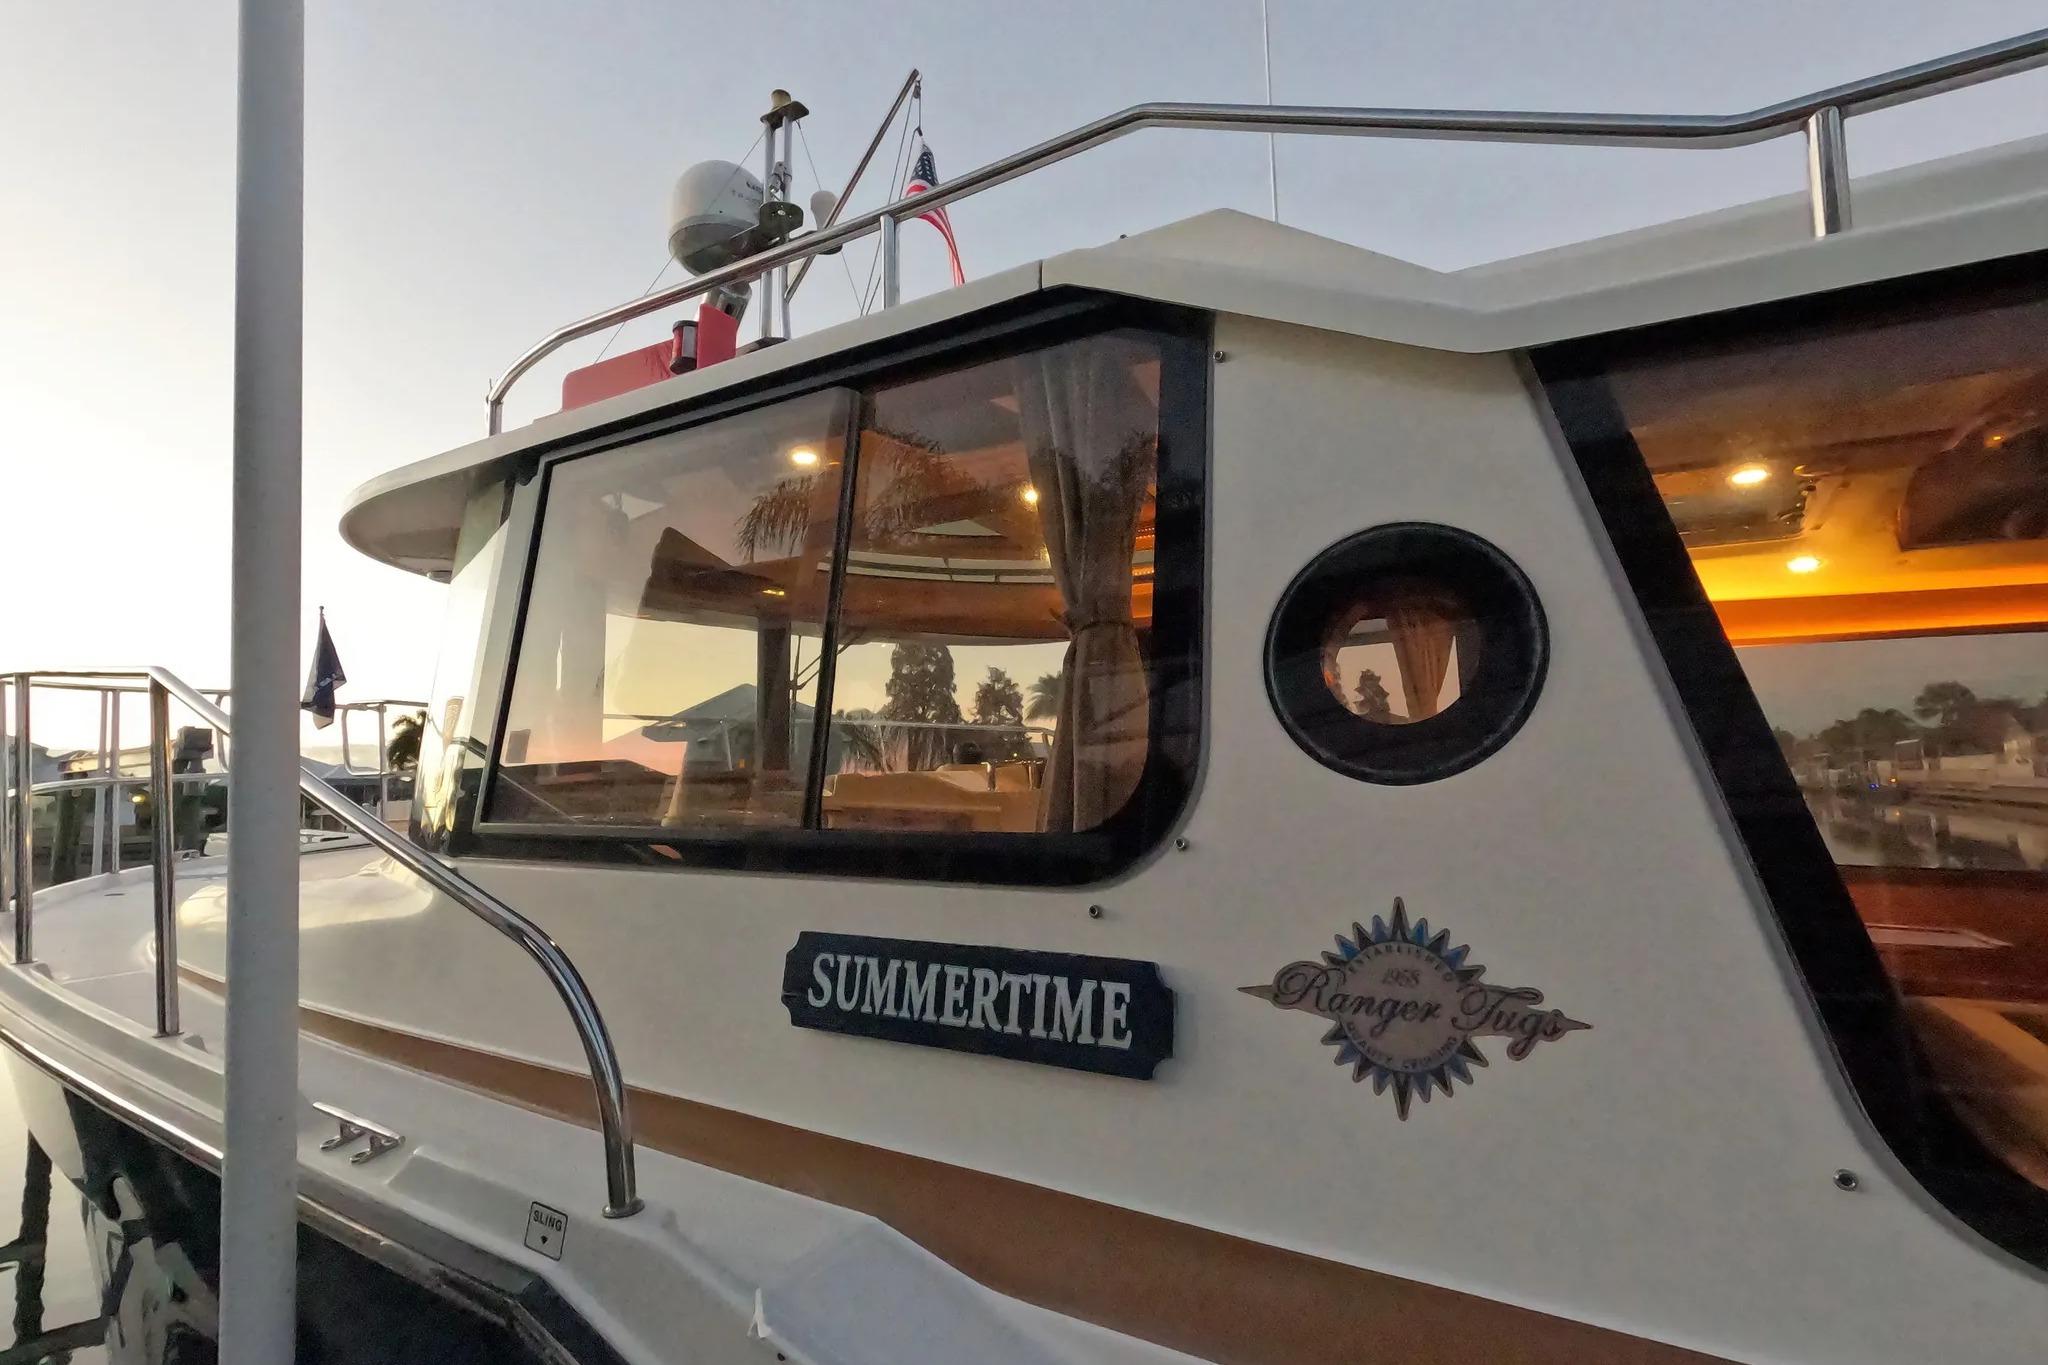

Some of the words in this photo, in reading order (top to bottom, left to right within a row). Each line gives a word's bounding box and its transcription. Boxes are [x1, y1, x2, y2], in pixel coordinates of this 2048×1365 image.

[807, 952, 1133, 1051] SUMMERTIME
[1273, 964, 1442, 1038] Ranger
[1451, 983, 1563, 1060] Tugs
[533, 1209, 563, 1232] SLING
